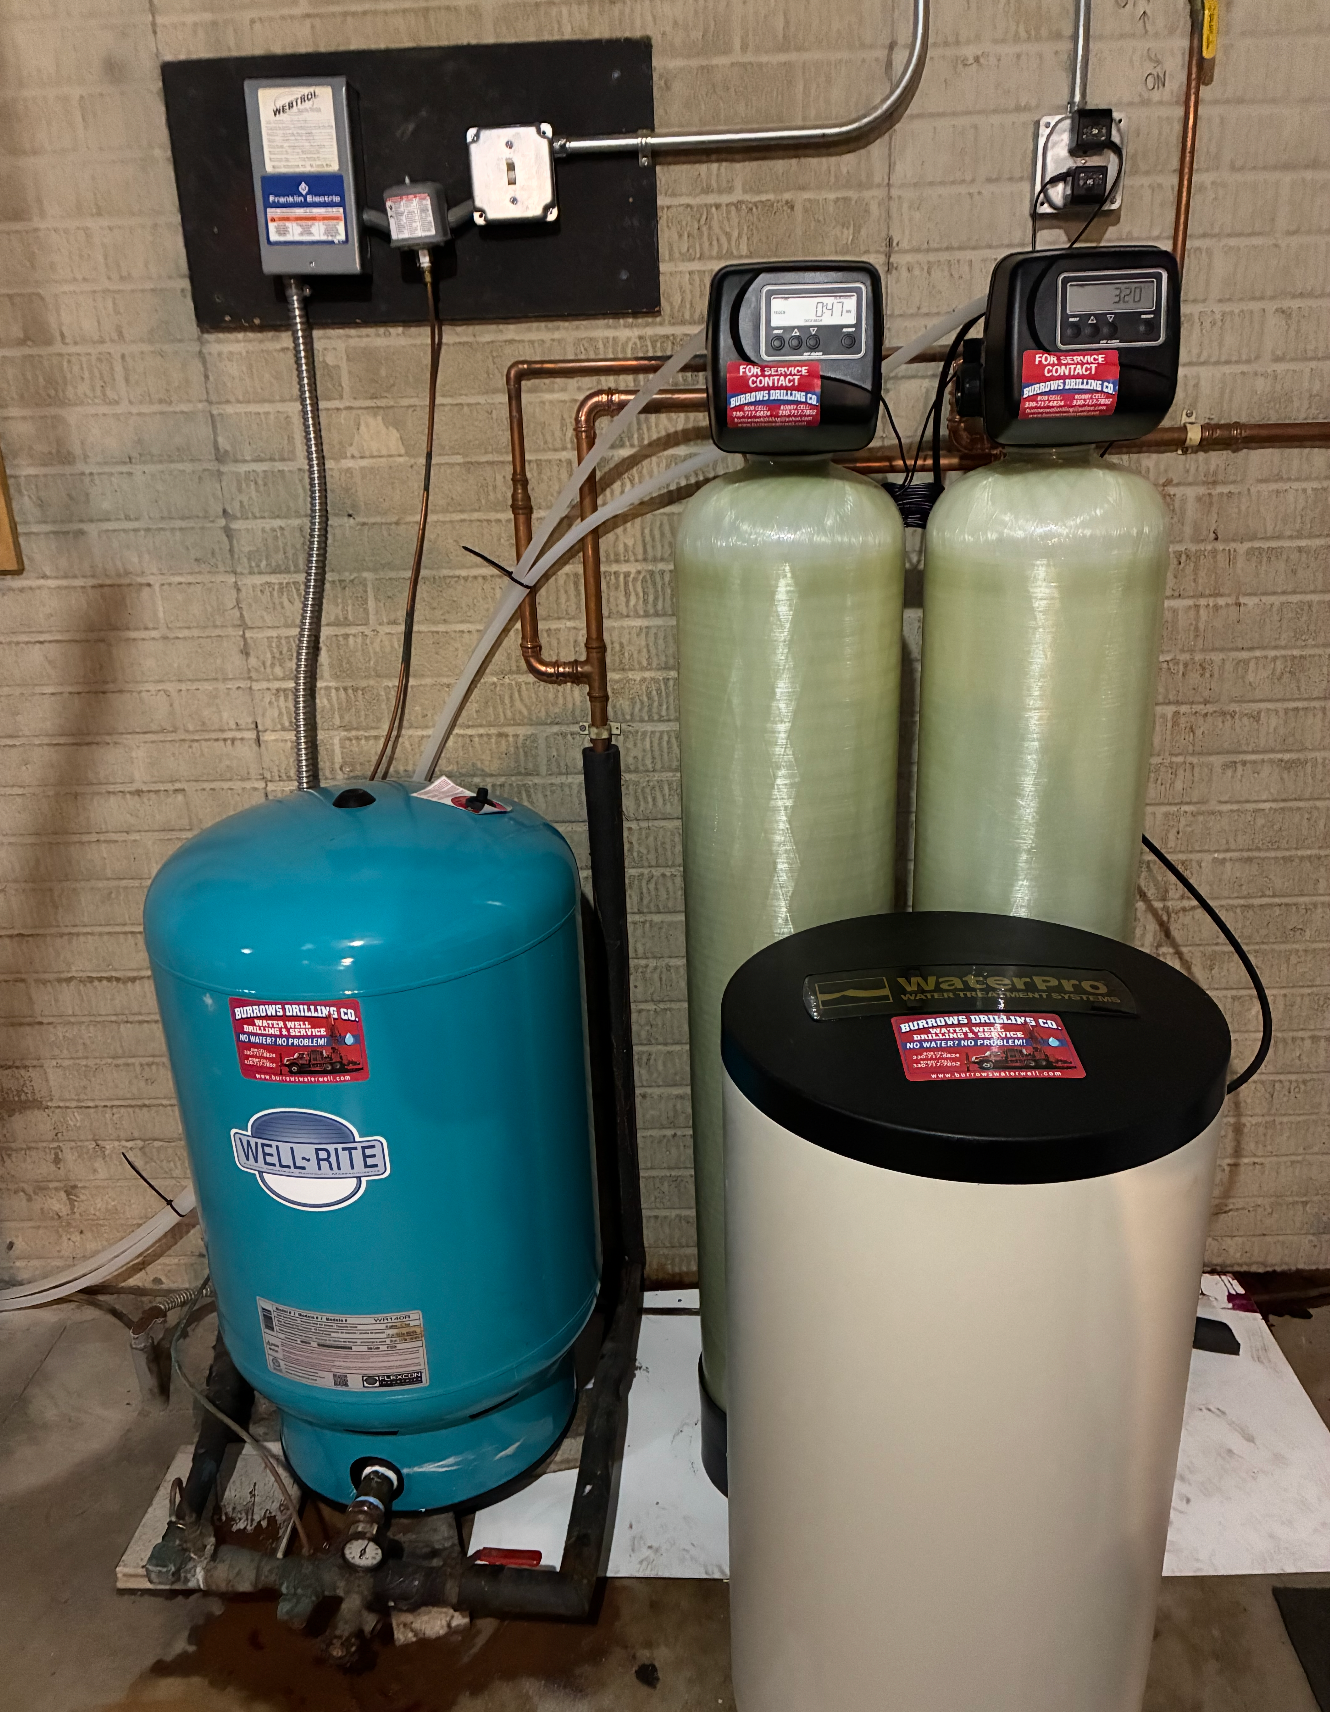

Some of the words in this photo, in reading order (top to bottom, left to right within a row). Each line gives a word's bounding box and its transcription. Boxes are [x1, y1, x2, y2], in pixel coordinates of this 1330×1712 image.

[1145, 70, 1167, 91] ON
[273, 90, 319, 117] WEBTROL
[269, 194, 305, 204] Franklin
[306, 194, 341, 203] Electric
[1112, 285, 1143, 305] 320
[1035, 354, 1058, 365] FOR
[1060, 355, 1106, 364] SERVICE
[739, 365, 762, 376] FOR
[764, 366, 809, 376] SERVICE
[1044, 364, 1098, 377] CONTACT
[749, 376, 801, 388] CONTACT
[1022, 380, 1064, 398] BURROWS
[1064, 379, 1102, 391] DRILLING
[1102, 382, 1116, 395] CO.
[730, 390, 769, 408] BURROWS
[770, 389, 806, 402] DRILLING
[806, 393, 819, 406] CO.
[896, 973, 1108, 994] WaterPro
[900, 991, 955, 1001] WATER
[957, 990, 1049, 999] TREATMENT
[1053, 992, 1121, 1004] SYSTEMS
[234, 1004, 284, 1020] BURROWS
[284, 1004, 339, 1019] DRILLING
[340, 1008, 359, 1022] CO.
[253, 1019, 285, 1028] WATER
[286, 1021, 312, 1029] WELL
[900, 1015, 969, 1033] BURROWS
[970, 1014, 1037, 1026] DRILLING
[1038, 1018, 1063, 1030] CO.
[243, 1025, 281, 1036] DRILLING
[290, 1028, 327, 1036] SERVICE
[912, 1033, 964, 1041] DRILLING
[239, 1033, 248, 1042] NO
[250, 1035, 275, 1045] WATER?
[276, 1037, 287, 1046] NO
[288, 1037, 327, 1046] PROBLEM!
[906, 1042, 920, 1050] NO
[922, 1041, 959, 1049] WATER?
[977, 1039, 1027, 1047] PROBLEM!
[930, 1071, 1062, 1079] www.burrowswaterwell.com
